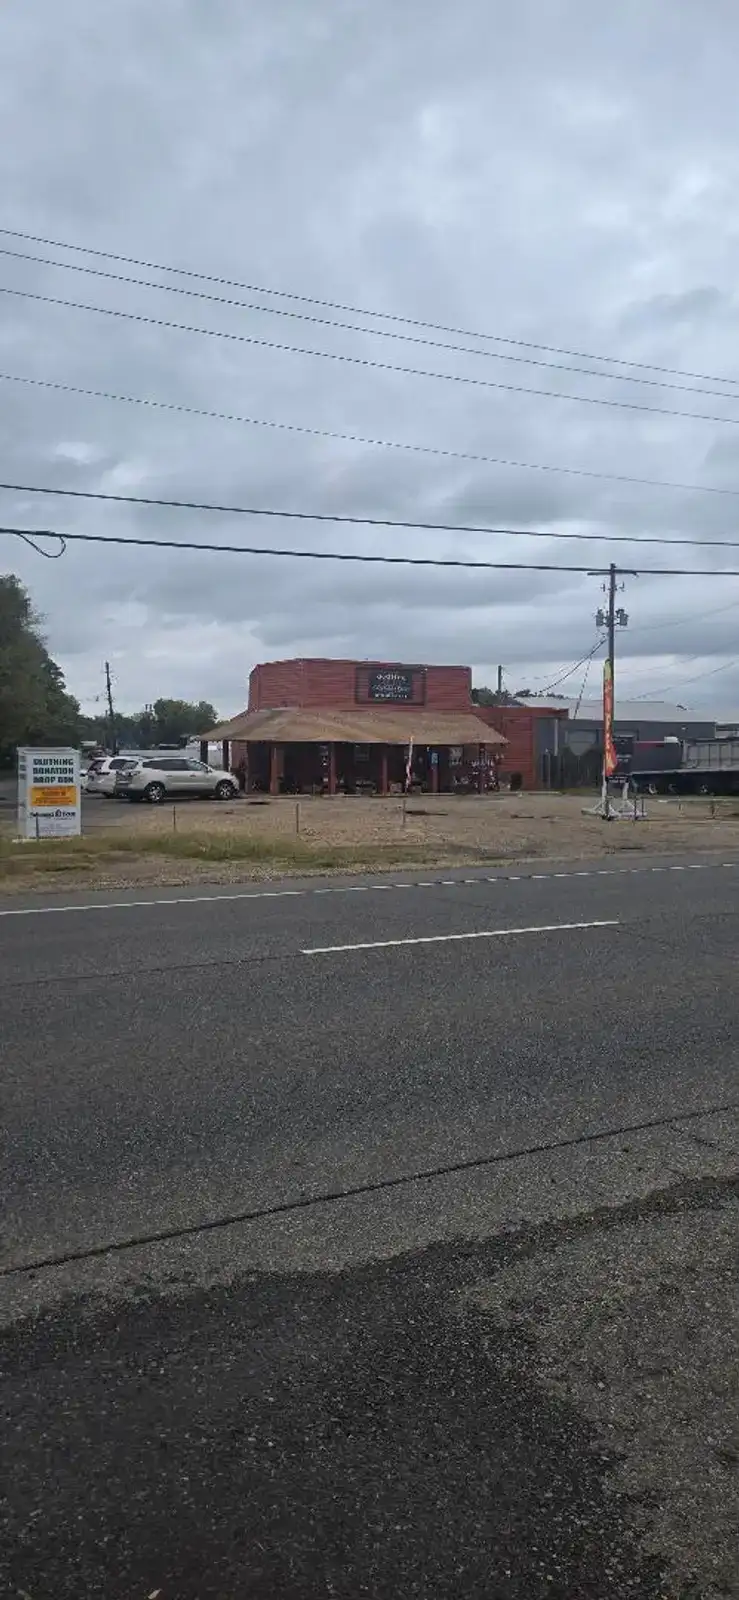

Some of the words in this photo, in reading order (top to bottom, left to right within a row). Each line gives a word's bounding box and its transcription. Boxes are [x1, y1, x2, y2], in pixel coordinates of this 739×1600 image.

[33, 758, 74, 766] CLOTHING
[33, 767, 74, 775] DONATION
[33, 776, 56, 784] DROP
